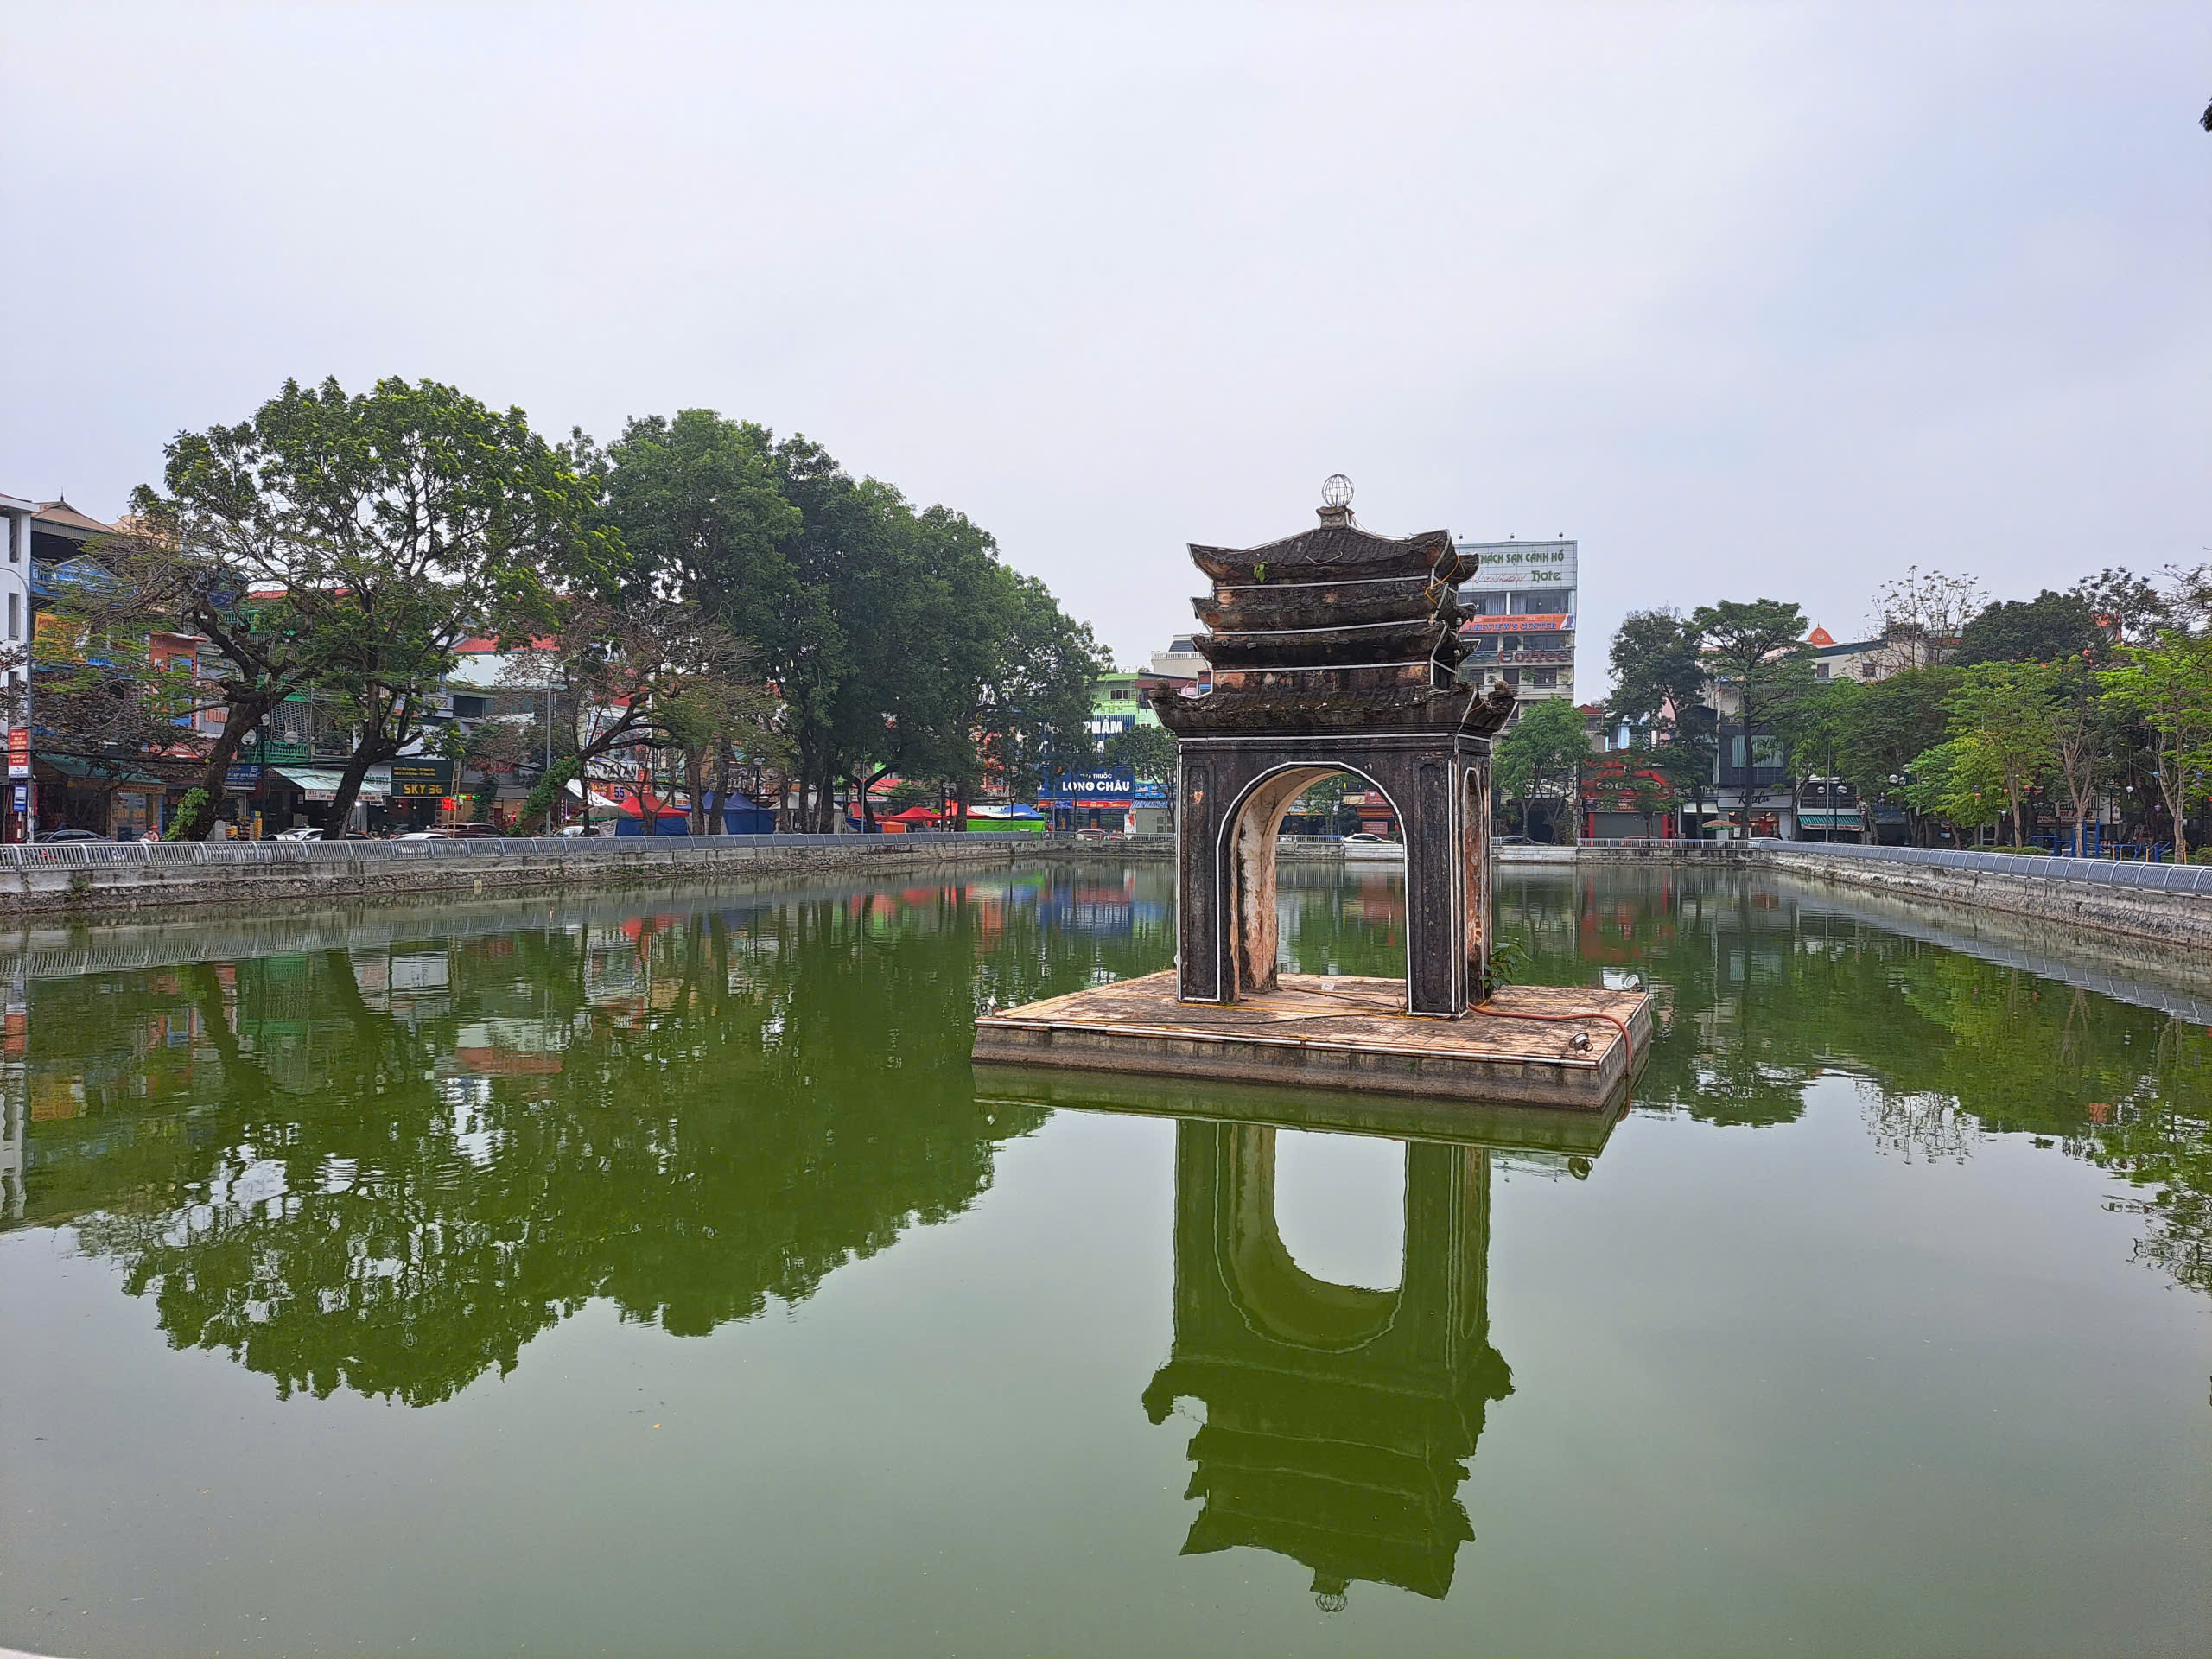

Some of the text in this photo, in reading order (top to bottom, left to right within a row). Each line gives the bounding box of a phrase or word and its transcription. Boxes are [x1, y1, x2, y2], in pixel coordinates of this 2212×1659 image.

[1462, 621, 1556, 632] LAKEVIEW'S CENTER
[1497, 649, 1570, 664] Coffee
[403, 784, 443, 794] SKY 36
[1063, 781, 1095, 791] LONG
[1096, 779, 1130, 791] CHÂU
[613, 786, 625, 798] 55
